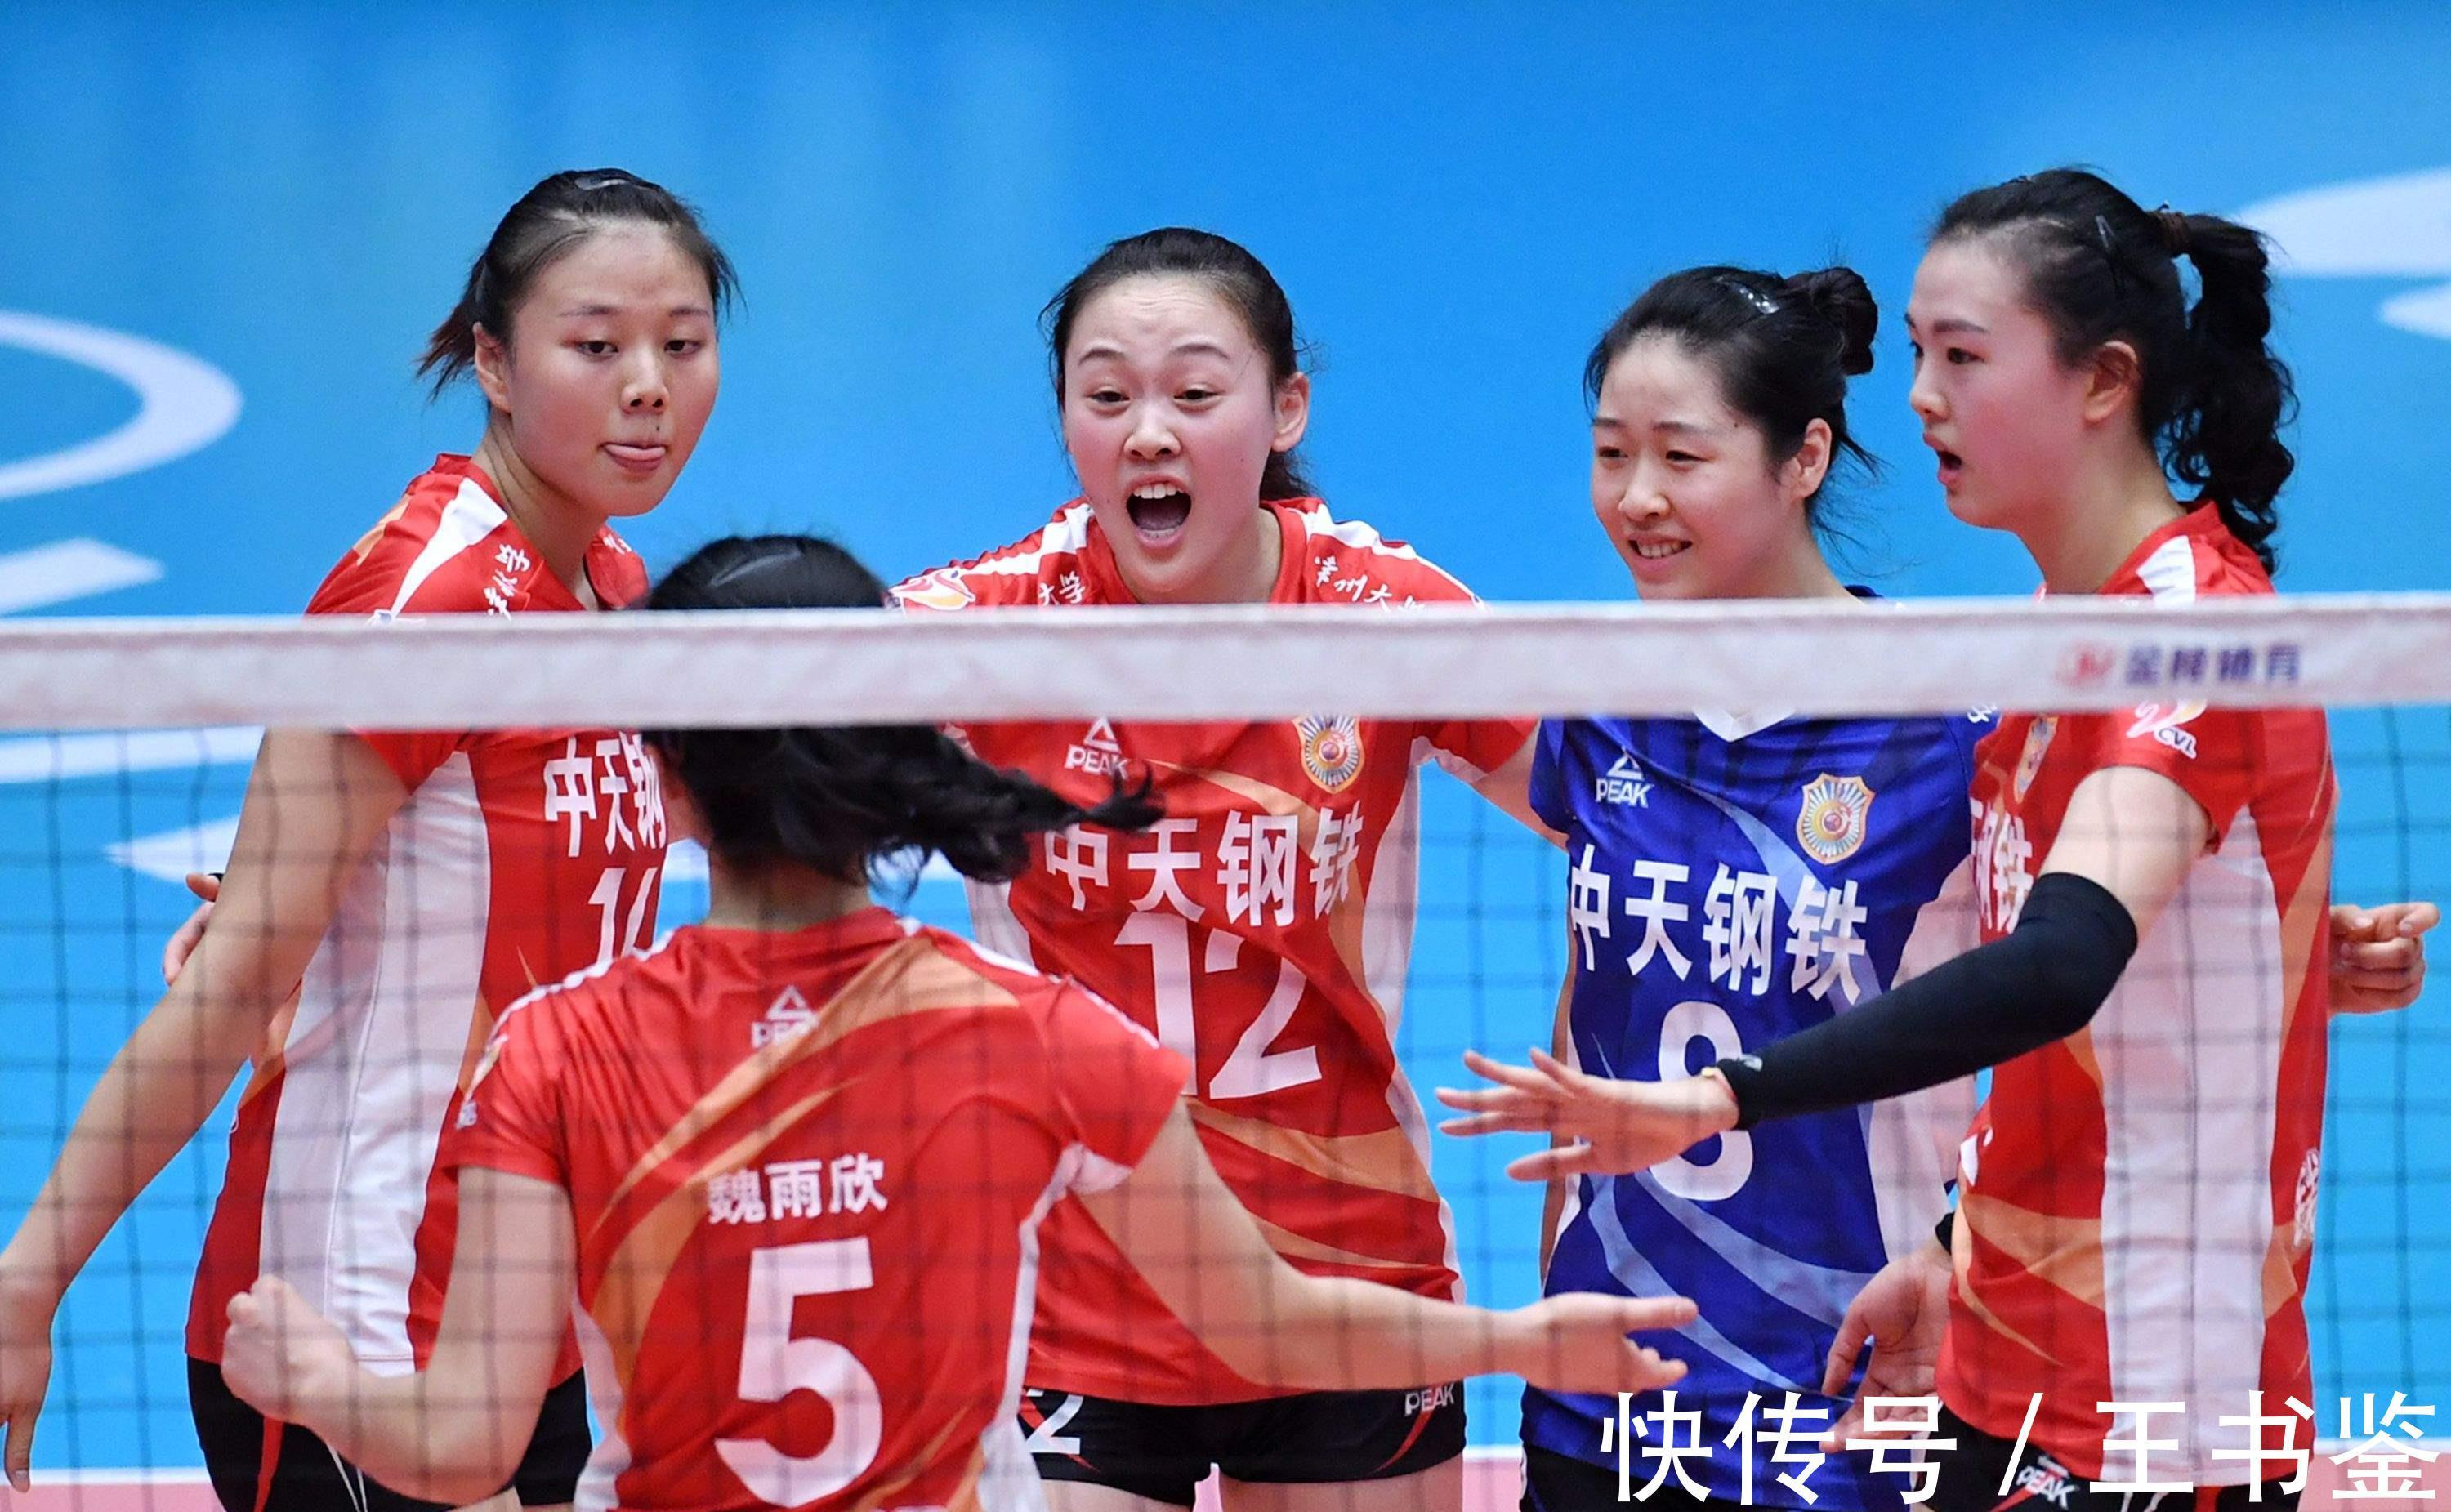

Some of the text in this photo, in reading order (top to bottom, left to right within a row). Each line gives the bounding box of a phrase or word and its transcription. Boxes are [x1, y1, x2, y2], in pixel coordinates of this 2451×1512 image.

[1064, 743, 1132, 781] PEAK
[1595, 777, 1656, 809] PEAK
[1044, 800, 1364, 927] 中天钢铁
[1570, 842, 1868, 1006] 中天钢铁
[1113, 910, 1323, 1100] 12
[708, 1152, 889, 1225] 魏雨欣
[714, 1236, 883, 1509] 5
[1404, 1382, 1456, 1416] PEAK
[2016, 1465, 2080, 1510] PEAK
